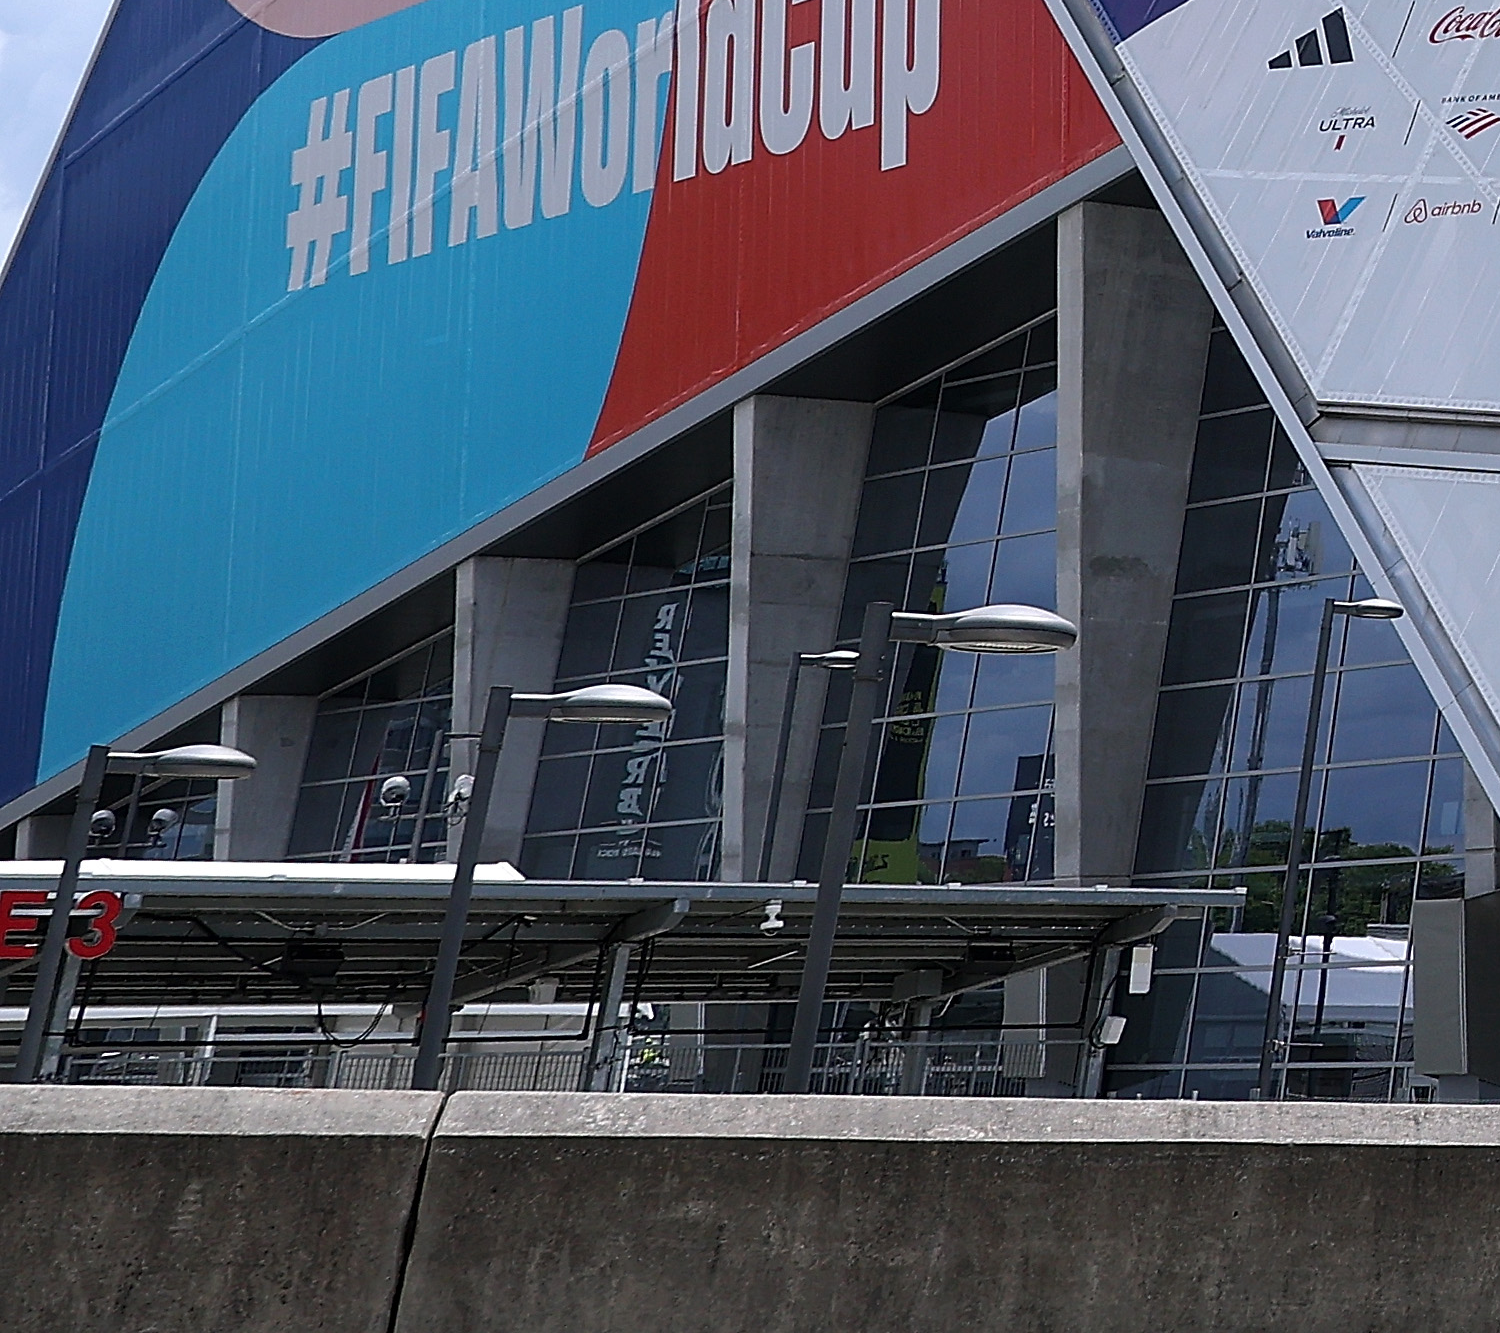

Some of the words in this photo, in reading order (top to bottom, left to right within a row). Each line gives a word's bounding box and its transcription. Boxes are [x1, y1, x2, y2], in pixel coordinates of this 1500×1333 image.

[1319, 116, 1376, 132] ULTRA
[1430, 199, 1482, 218] airbnb
[65, 889, 122, 960] 3
